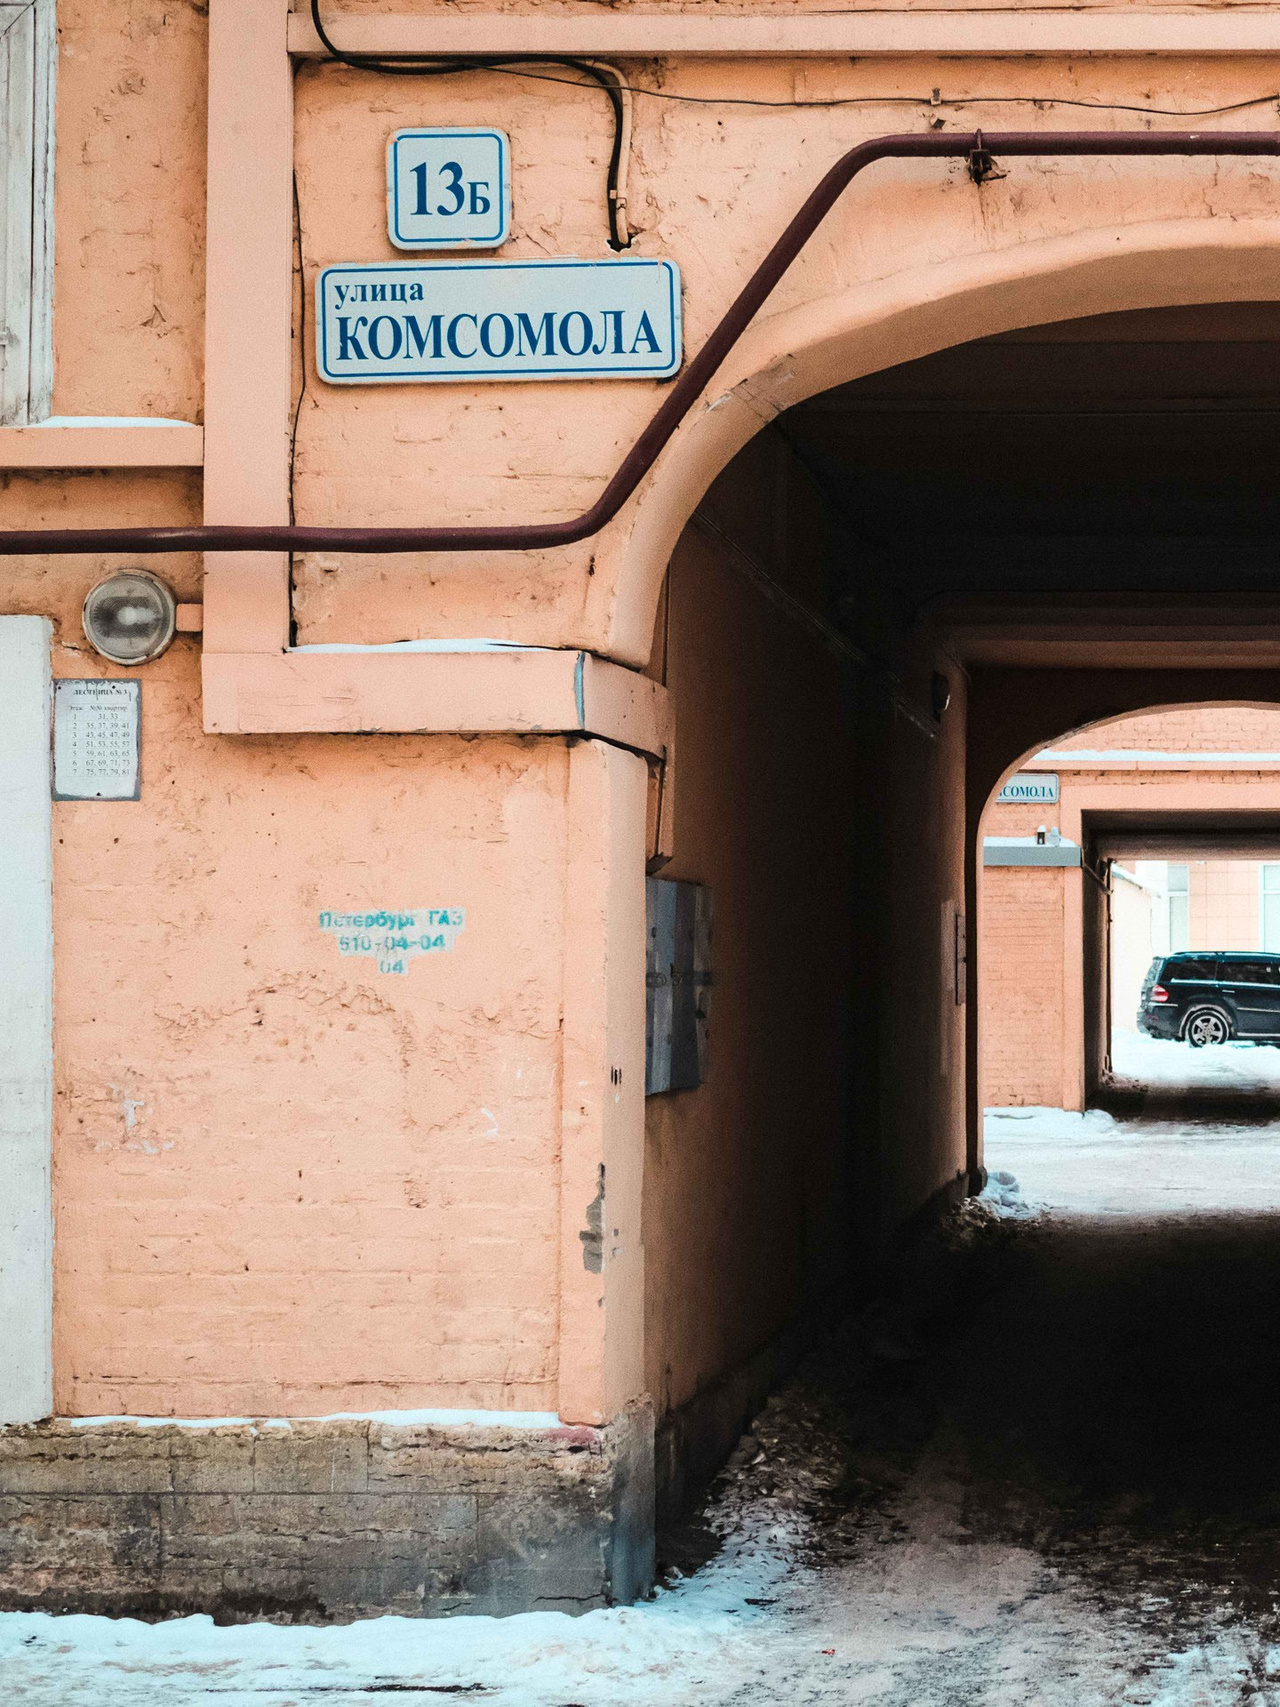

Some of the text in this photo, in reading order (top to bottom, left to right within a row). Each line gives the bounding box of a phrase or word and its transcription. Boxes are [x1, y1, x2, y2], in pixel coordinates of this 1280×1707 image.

[409, 161, 491, 216] 13Б
[334, 282, 424, 310] улица
[335, 310, 663, 361] КОМСОМОЛА
[1000, 786, 1054, 797] СОМОЛА
